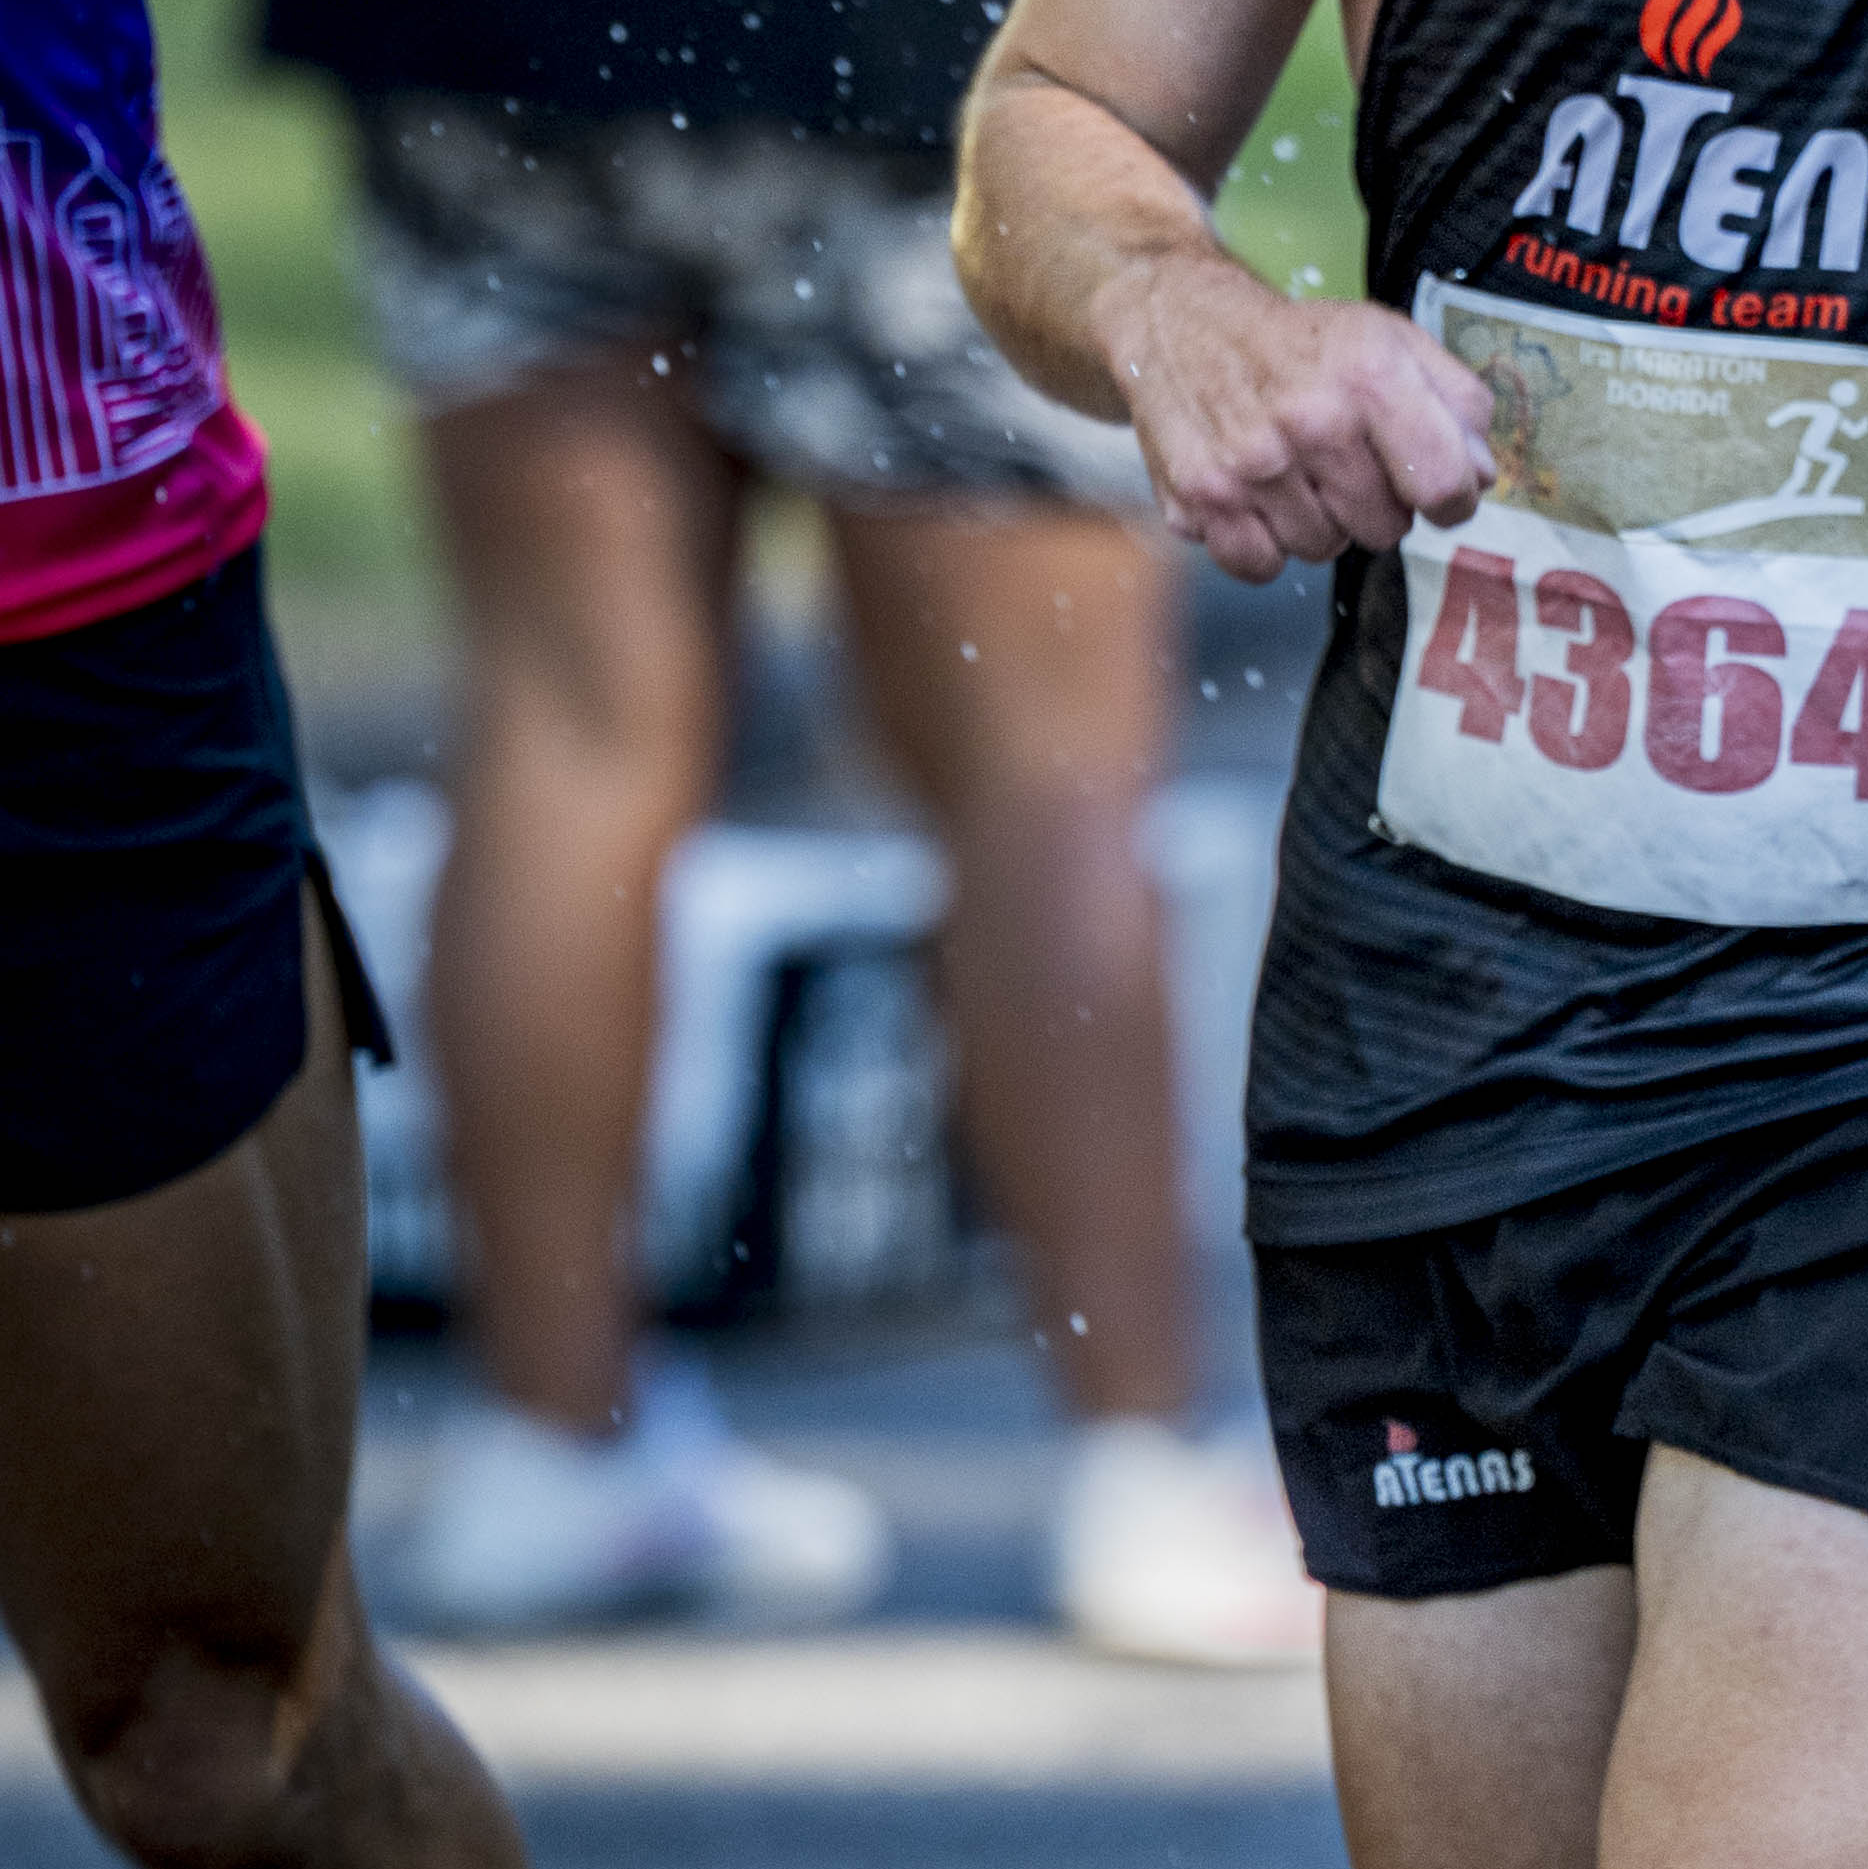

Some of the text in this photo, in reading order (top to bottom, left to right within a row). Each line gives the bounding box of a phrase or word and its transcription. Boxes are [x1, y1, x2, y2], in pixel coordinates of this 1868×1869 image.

[1504, 232, 1850, 332] running team
[1373, 1447, 1537, 1508] ATENAS
